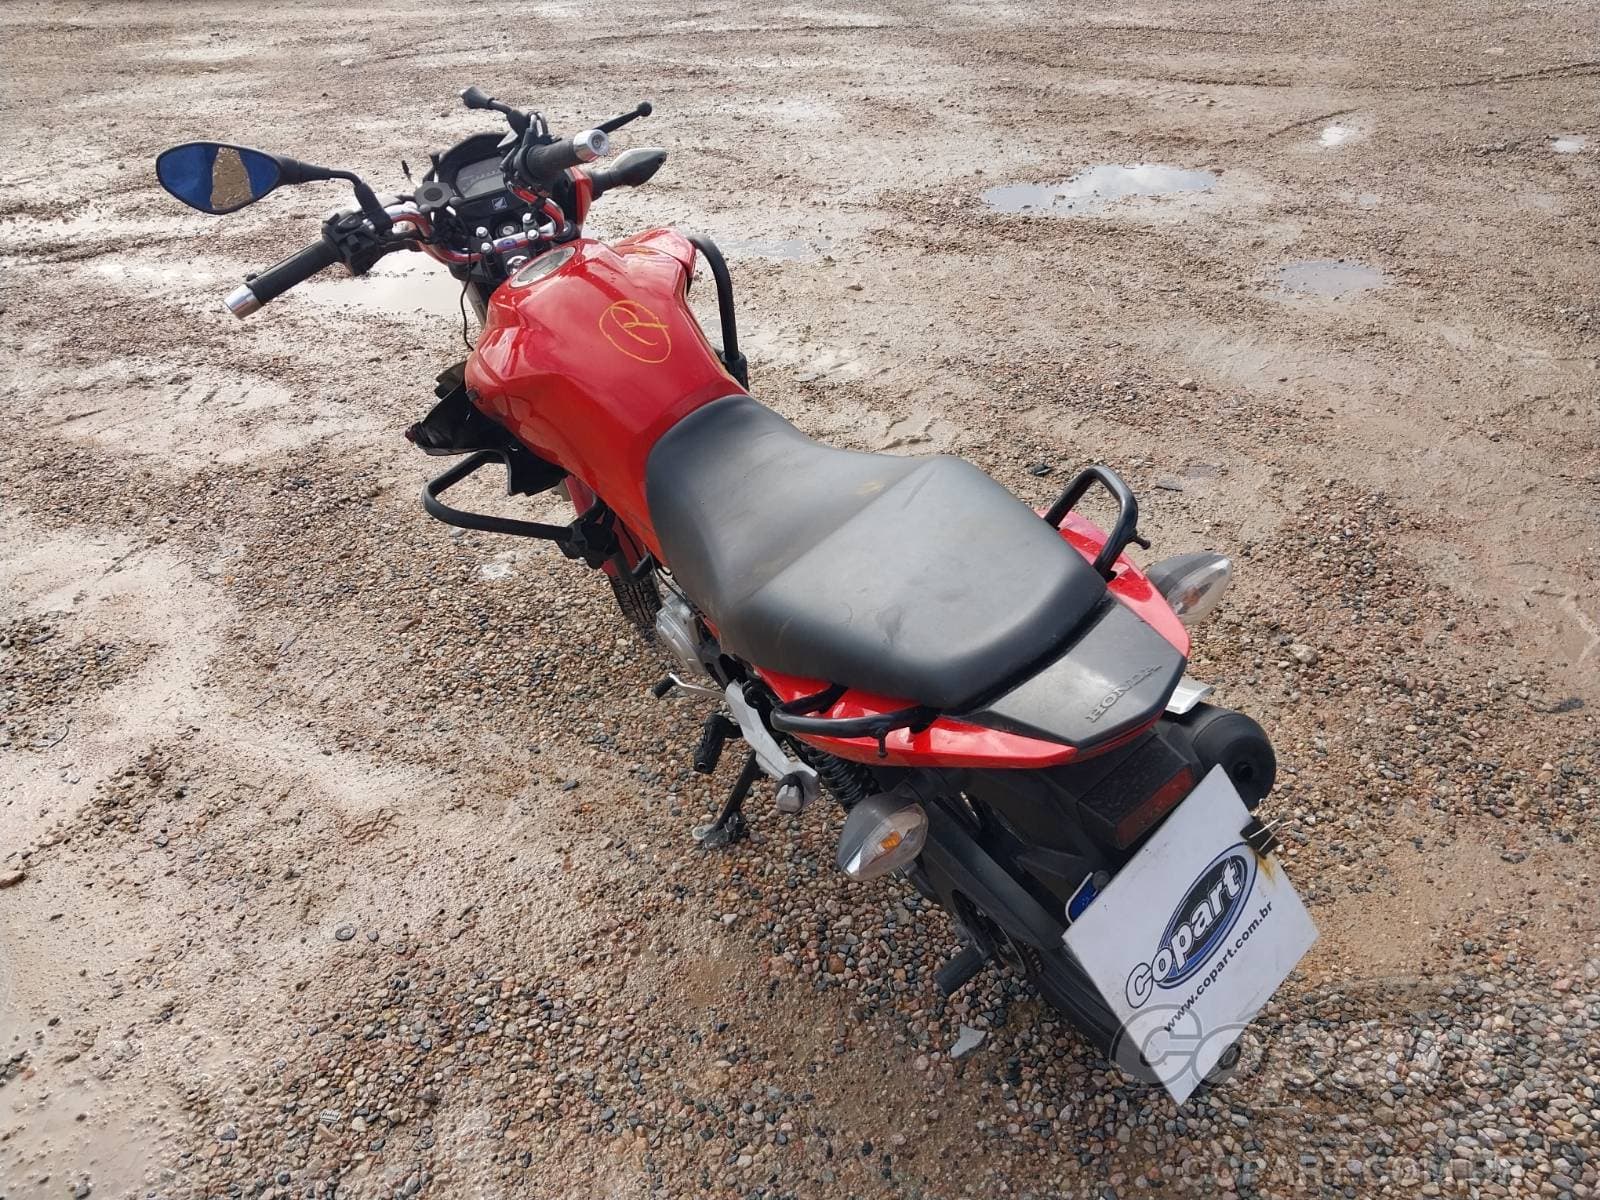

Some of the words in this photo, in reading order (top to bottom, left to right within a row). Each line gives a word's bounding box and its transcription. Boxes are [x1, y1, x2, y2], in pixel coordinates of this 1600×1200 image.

[1085, 665, 1163, 723] HONDA
[1126, 857, 1242, 1009] Copart
[1164, 901, 1273, 1033] www.copart.com.br
